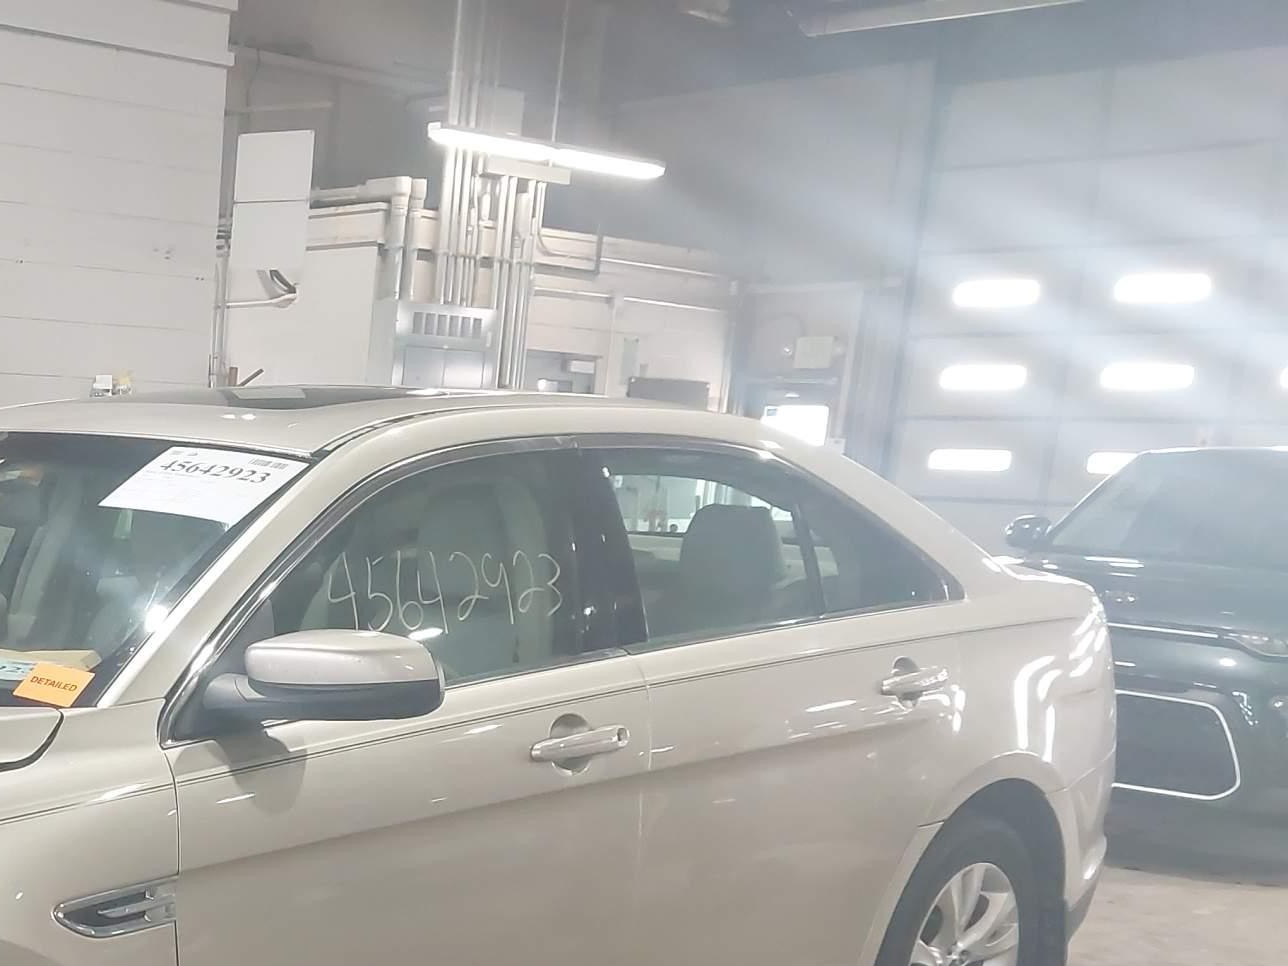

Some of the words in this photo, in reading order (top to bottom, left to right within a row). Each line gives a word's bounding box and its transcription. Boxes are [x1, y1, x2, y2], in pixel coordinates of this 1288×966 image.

[160, 459, 272, 484] 45642923
[327, 550, 563, 635] 45642923
[29, 675, 79, 692] DETAILED
